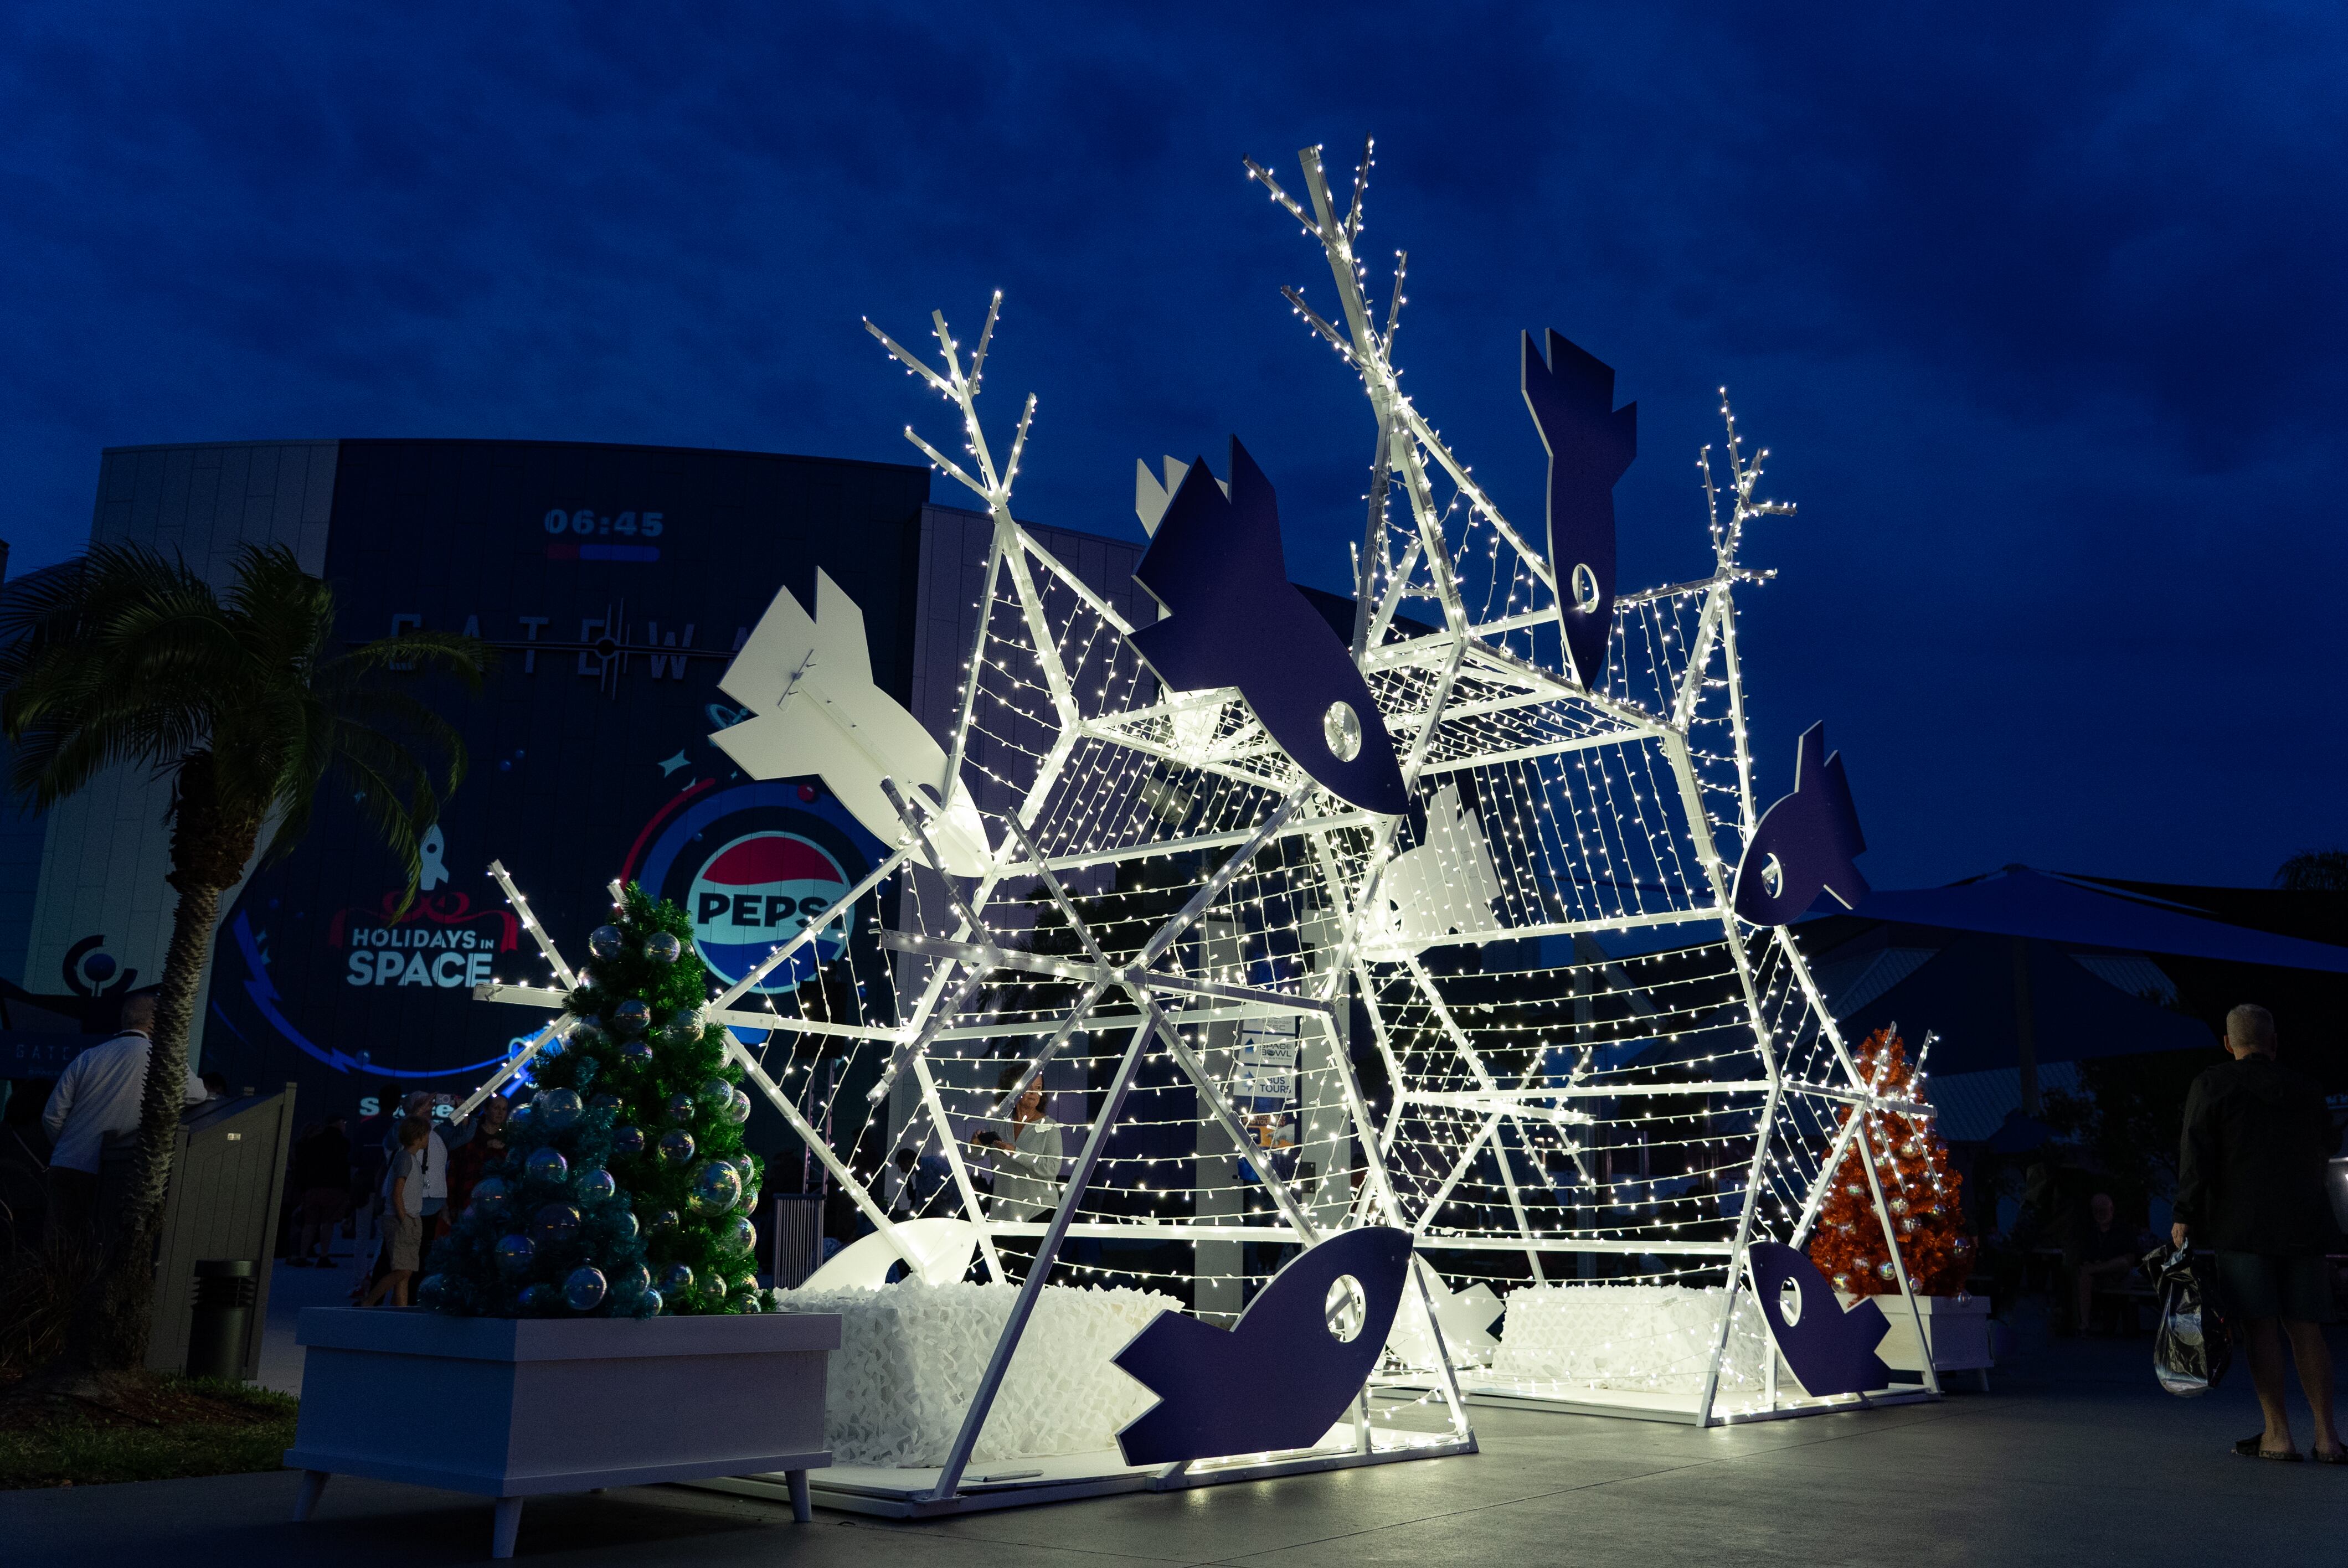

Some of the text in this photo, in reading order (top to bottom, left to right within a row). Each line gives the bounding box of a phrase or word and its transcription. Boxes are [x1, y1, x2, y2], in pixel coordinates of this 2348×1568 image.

[544, 509, 664, 537] 06:45
[352, 927, 495, 949] HOLIDAYS IN
[346, 950, 493, 988] SPACE
[1260, 1084, 1292, 1094] TOURS
